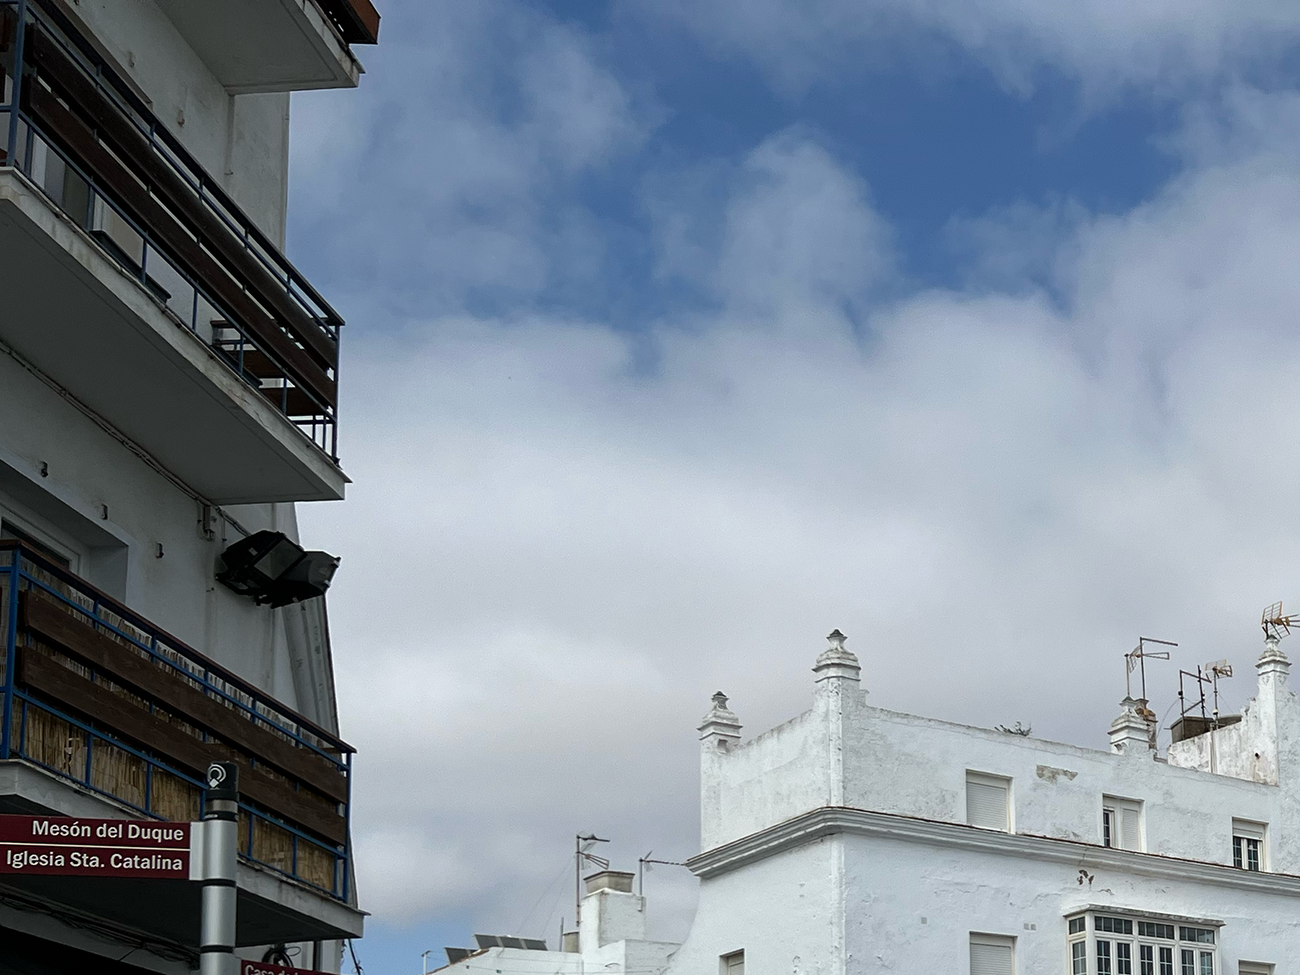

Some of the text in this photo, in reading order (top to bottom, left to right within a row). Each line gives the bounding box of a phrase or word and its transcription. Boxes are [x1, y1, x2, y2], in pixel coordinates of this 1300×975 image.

[32, 820, 184, 843] Mesón del Duque
[6, 850, 183, 870] Iglesia Sta. Catalina
